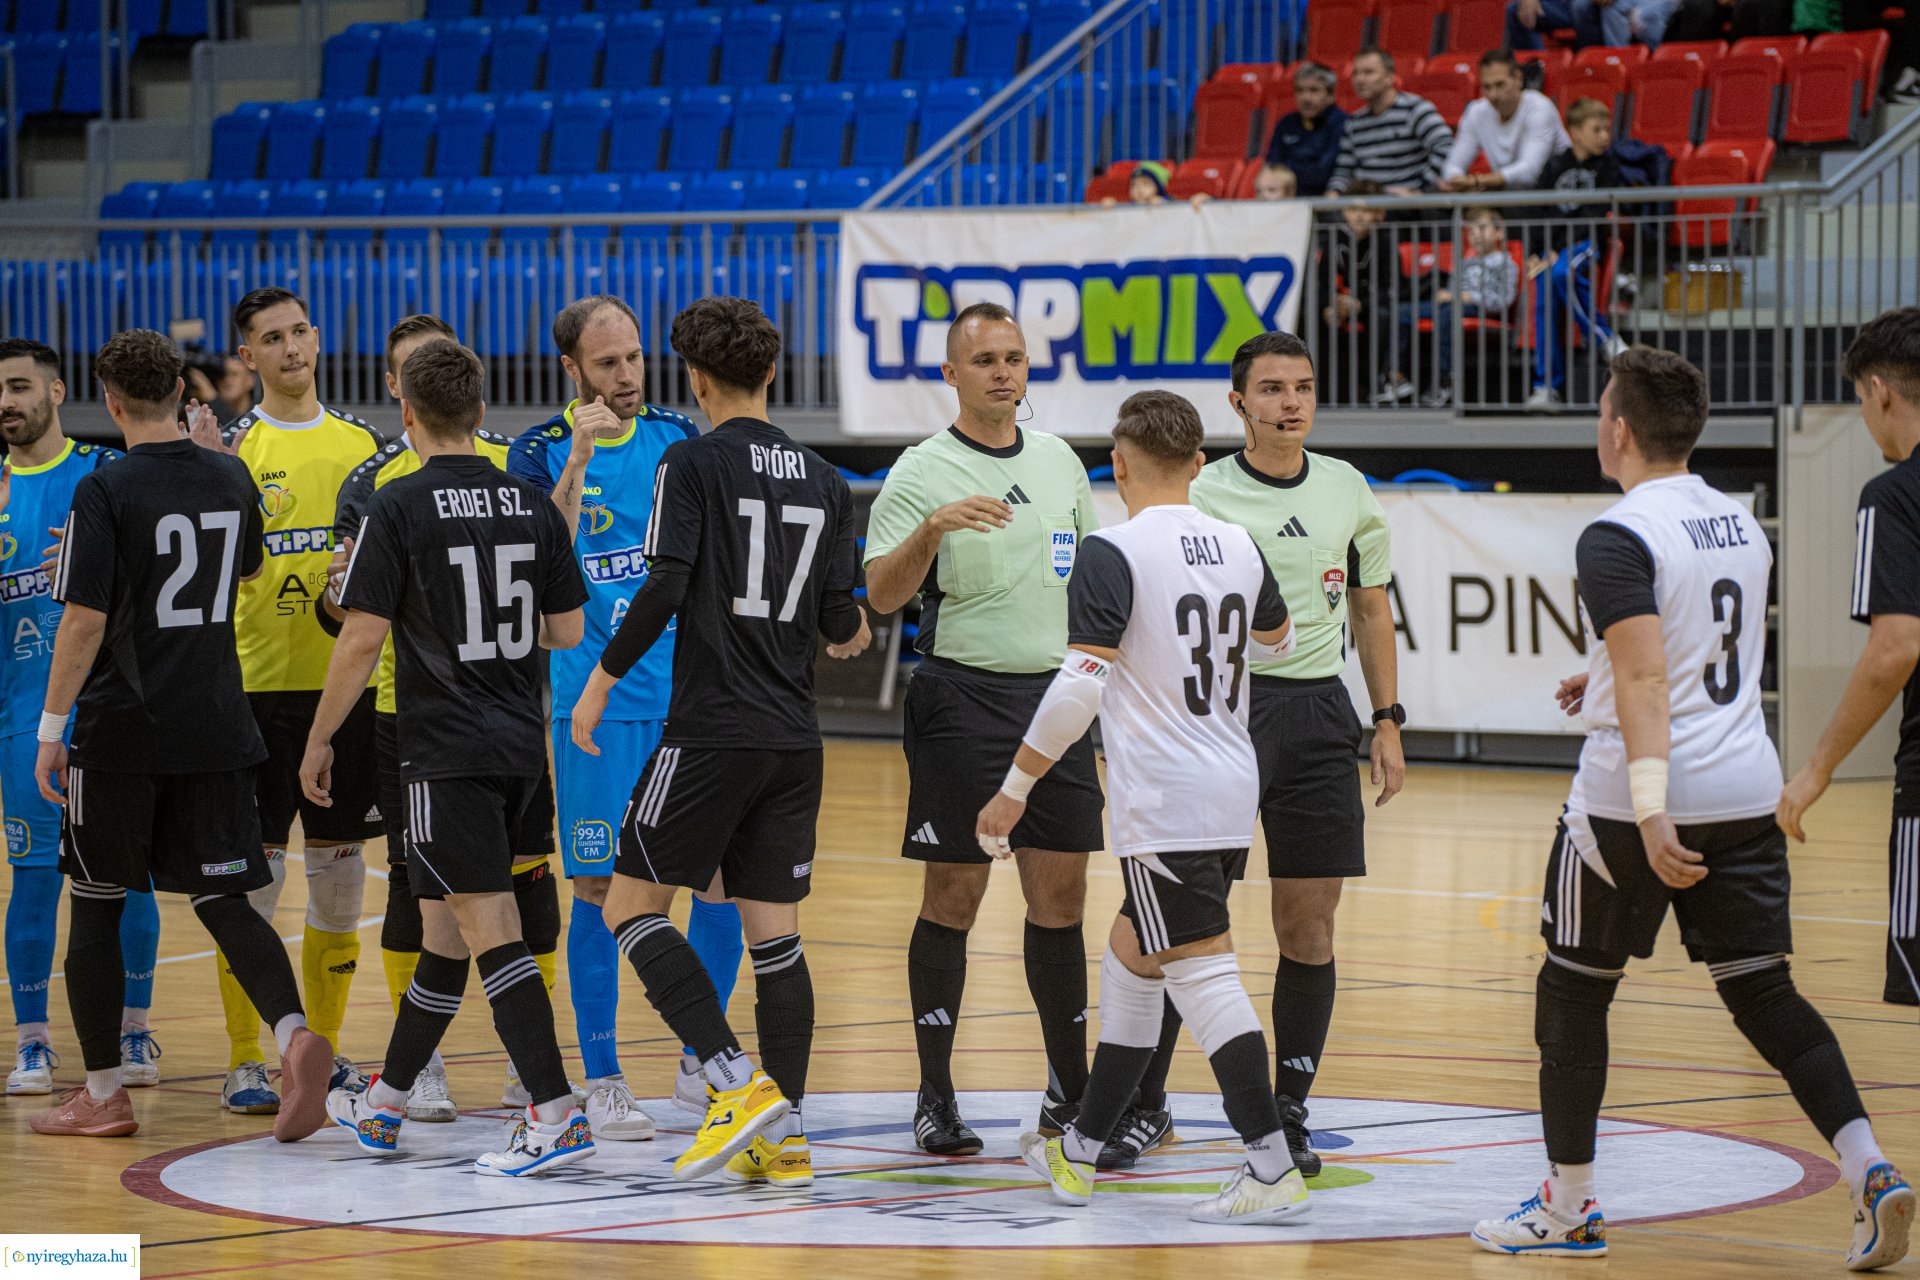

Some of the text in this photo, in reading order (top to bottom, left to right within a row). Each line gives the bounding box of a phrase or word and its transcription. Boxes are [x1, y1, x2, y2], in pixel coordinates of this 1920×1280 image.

[260, 470, 287, 482] JAKO
[749, 443, 807, 480] GYŐRI
[432, 487, 493, 519] ERDEI
[496, 486, 533, 517] SZ.
[582, 486, 603, 496] AKO
[1052, 533, 1075, 545] FIFA
[1681, 513, 1750, 551] VINCZE
[732, 497, 826, 623] 17
[1180, 534, 1224, 566] GALI
[155, 510, 241, 628] 27
[448, 543, 536, 662] 15
[1175, 592, 1247, 717] 33
[1702, 577, 1743, 706] 3
[577, 826, 605, 840] 99.4
[584, 847, 600, 857] FM
[17, 979, 49, 993] JAKO
[125, 969, 154, 981] JAKO
[588, 1028, 617, 1042] JAKO
